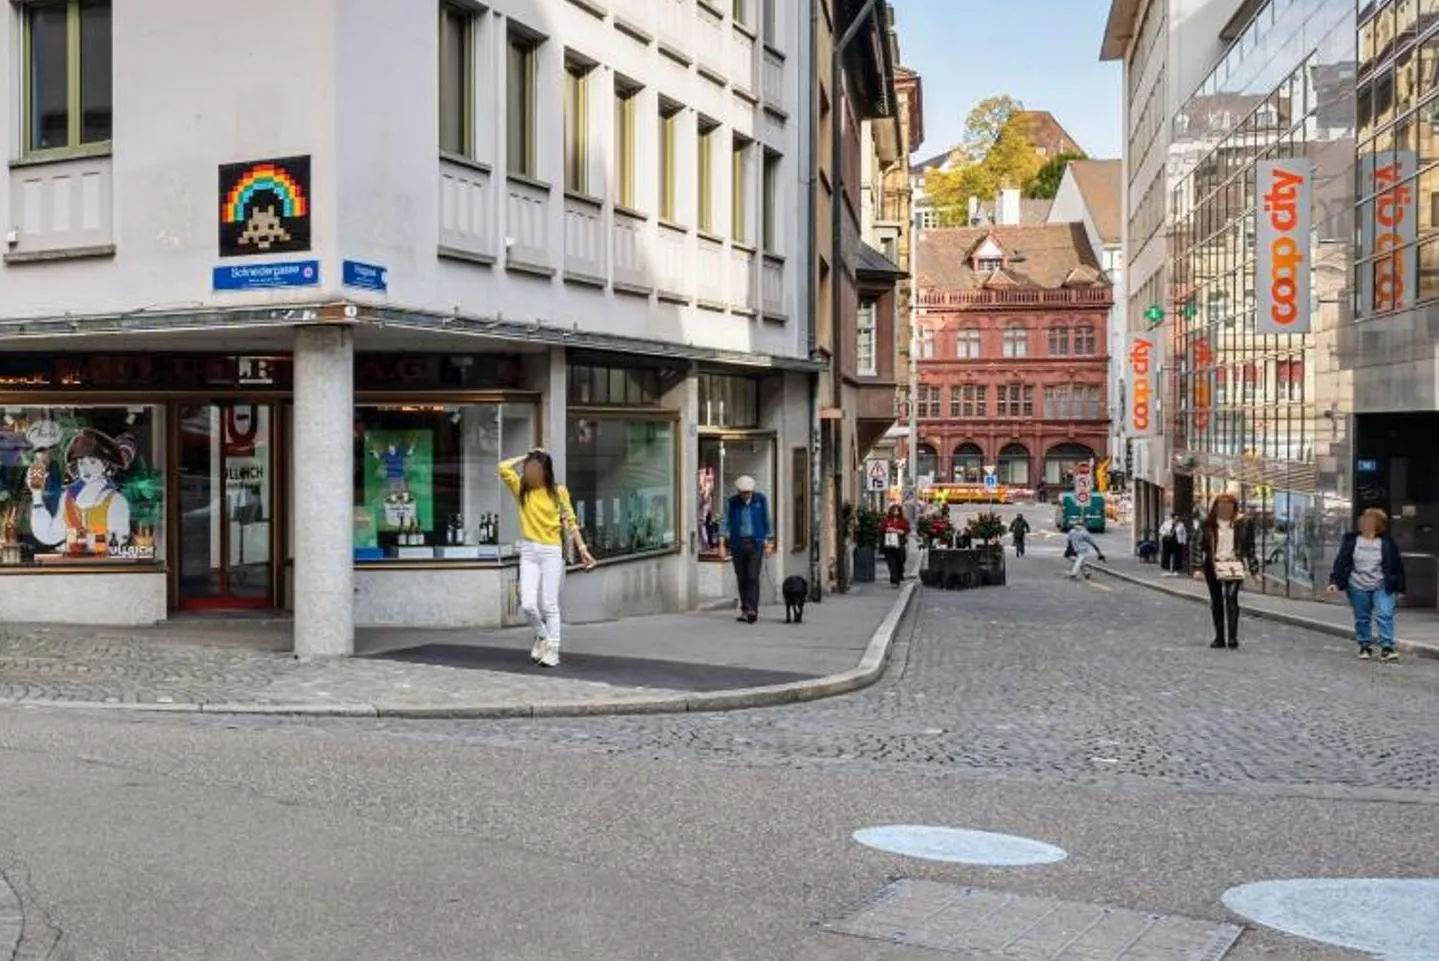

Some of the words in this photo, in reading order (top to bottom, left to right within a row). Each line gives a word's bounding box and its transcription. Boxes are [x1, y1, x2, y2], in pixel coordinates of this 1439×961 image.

[1264, 169, 1304, 232] city
[1271, 237, 1304, 325] coop
[1130, 339, 1152, 375] city
[1134, 379, 1152, 430] coop
